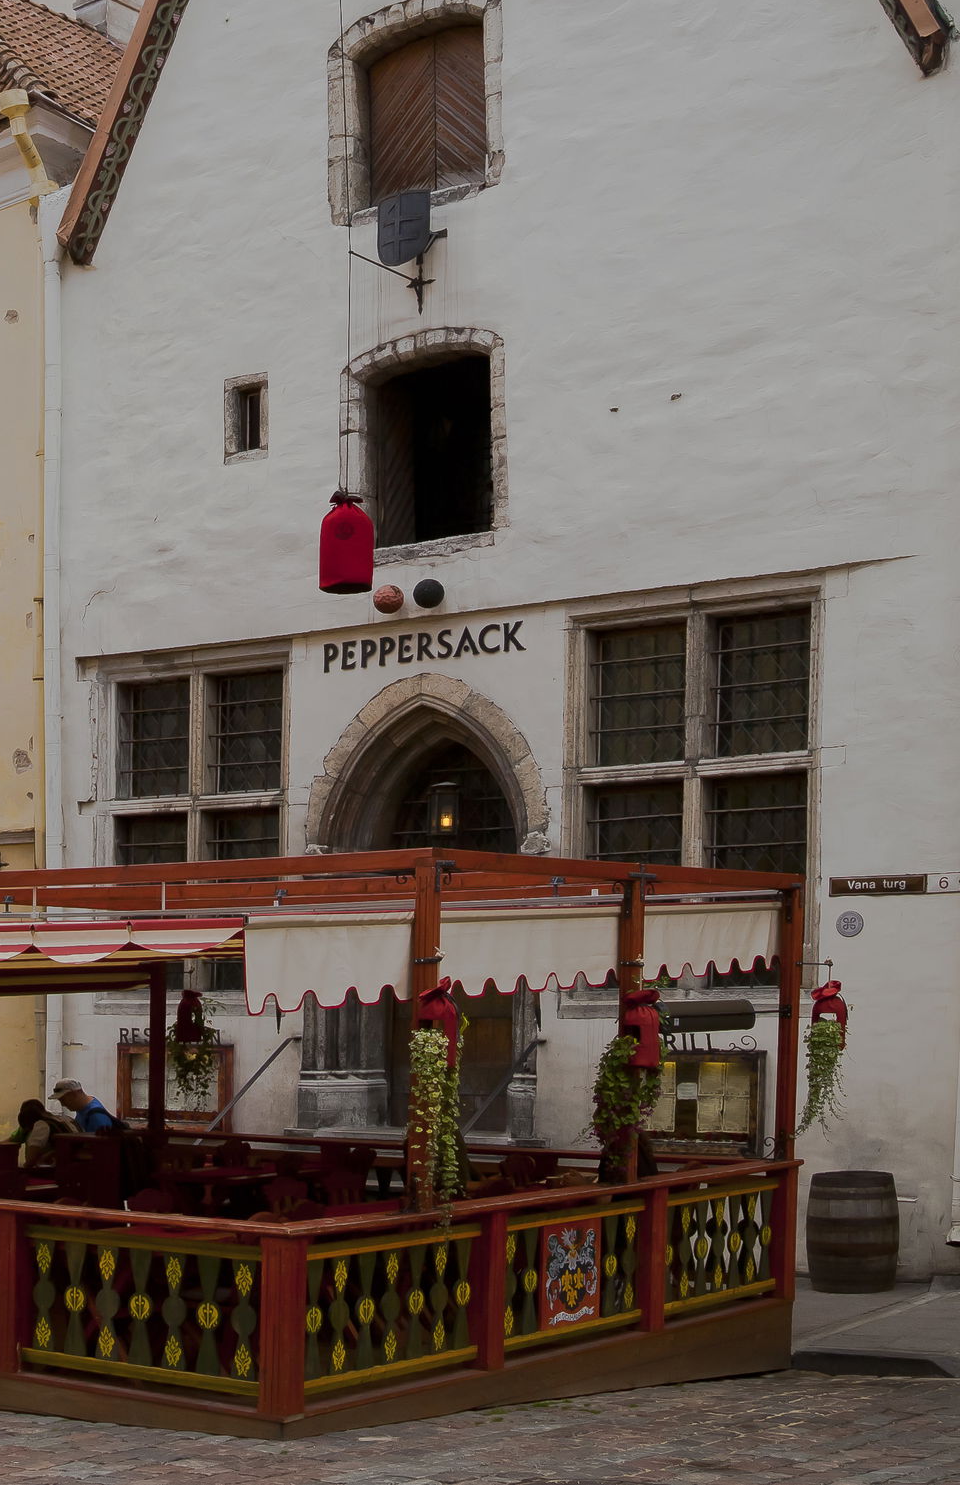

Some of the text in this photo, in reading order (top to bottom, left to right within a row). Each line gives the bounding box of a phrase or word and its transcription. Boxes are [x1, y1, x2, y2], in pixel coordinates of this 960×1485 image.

[323, 620, 527, 673] PEPPERSACK
[847, 876, 949, 890] Vana turg 6
